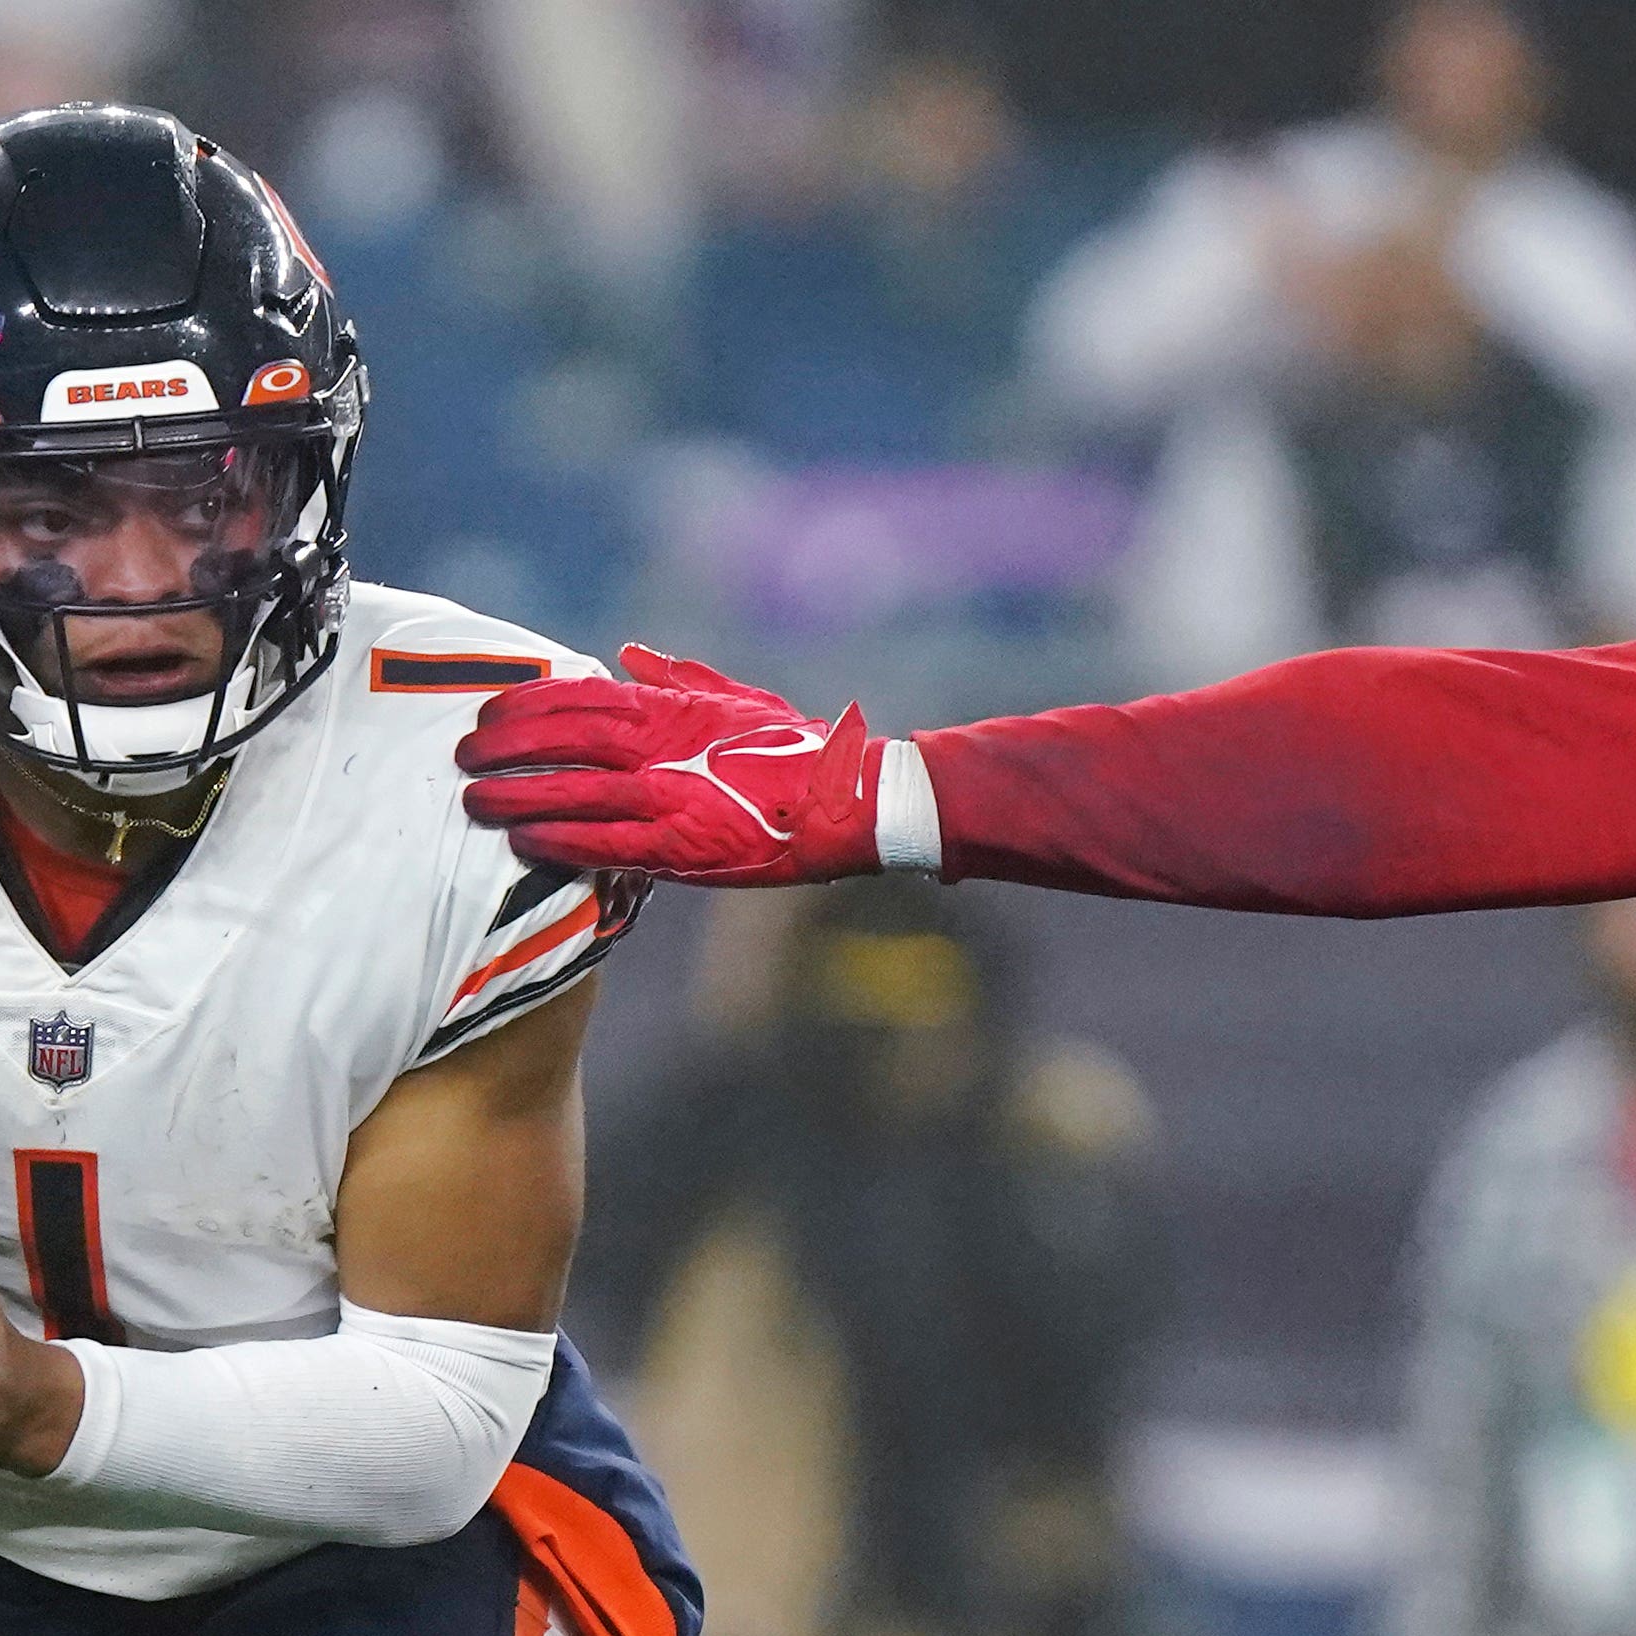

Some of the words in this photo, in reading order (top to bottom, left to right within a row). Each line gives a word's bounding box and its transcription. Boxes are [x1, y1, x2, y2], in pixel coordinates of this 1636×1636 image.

[66, 377, 189, 406] BEARS
[38, 1047, 84, 1078] NFL
[14, 1147, 126, 1343] 1
